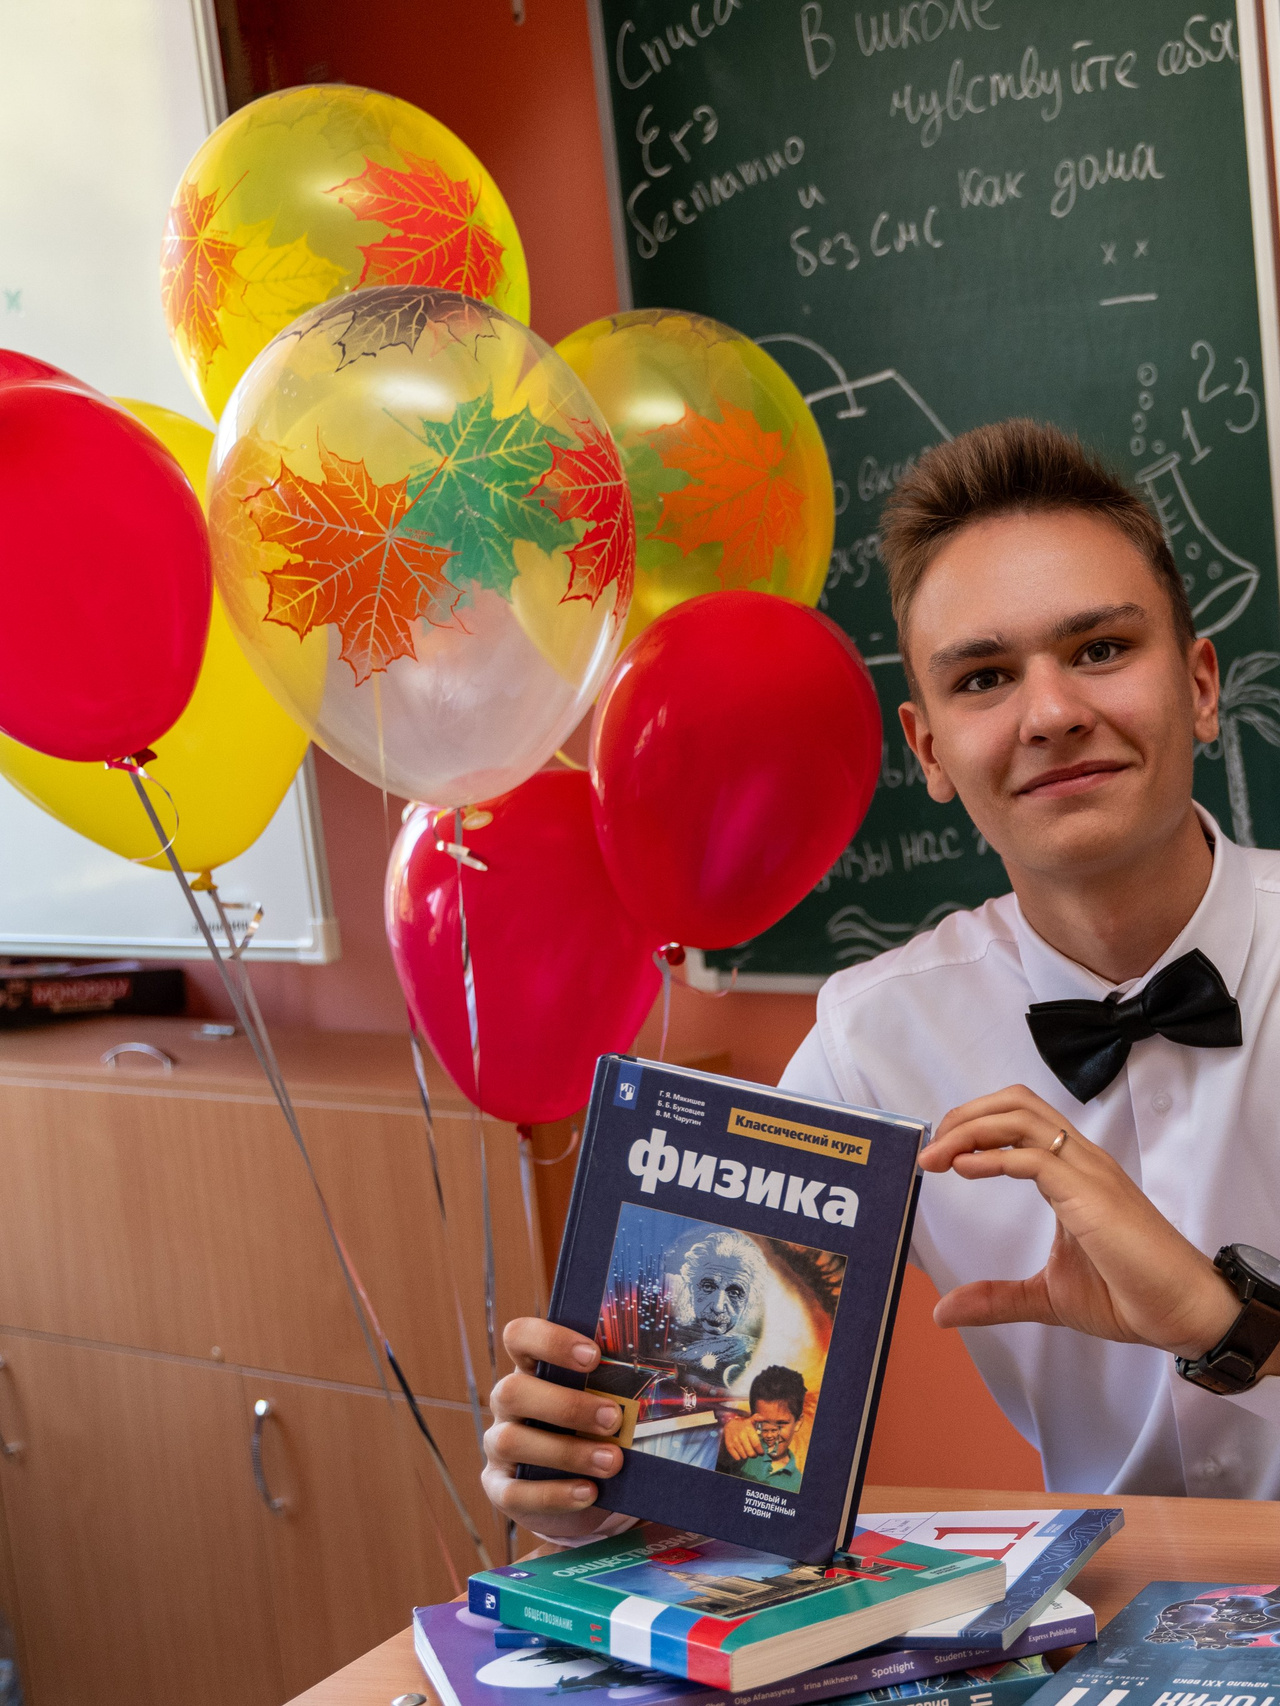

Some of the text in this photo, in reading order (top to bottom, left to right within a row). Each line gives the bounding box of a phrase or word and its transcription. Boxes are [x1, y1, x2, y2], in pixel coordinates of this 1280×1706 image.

[889, 14, 1240, 148] чувствуйте себя
[1050, 142, 1165, 218] дома
[790, 226, 860, 277] без
[735, 1114, 863, 1155] Классический курс
[628, 1128, 860, 1228] физика
[744, 1497, 796, 1517] УГЛУБЛЁННЫЙ
[746, 1489, 787, 1506] БАЗОВЫЙ И
[743, 1505, 772, 1519] УРОВНИ
[523, 1606, 573, 1631] ОБЩЕСТВОЗНАНИЕ
[753, 1686, 796, 1702] Afanasyeva
[803, 1681, 822, 1691] Irina
[823, 1673, 858, 1688] Mikheeva
[871, 1661, 915, 1678] Spotlight
[934, 1649, 973, 1664] Student's
[1028, 1632, 1049, 1643] Express
[1049, 1626, 1077, 1638] Publishing
[1172, 1677, 1200, 1686] века
[1202, 1679, 1225, 1688] XXI
[1226, 1680, 1270, 1688] начало
